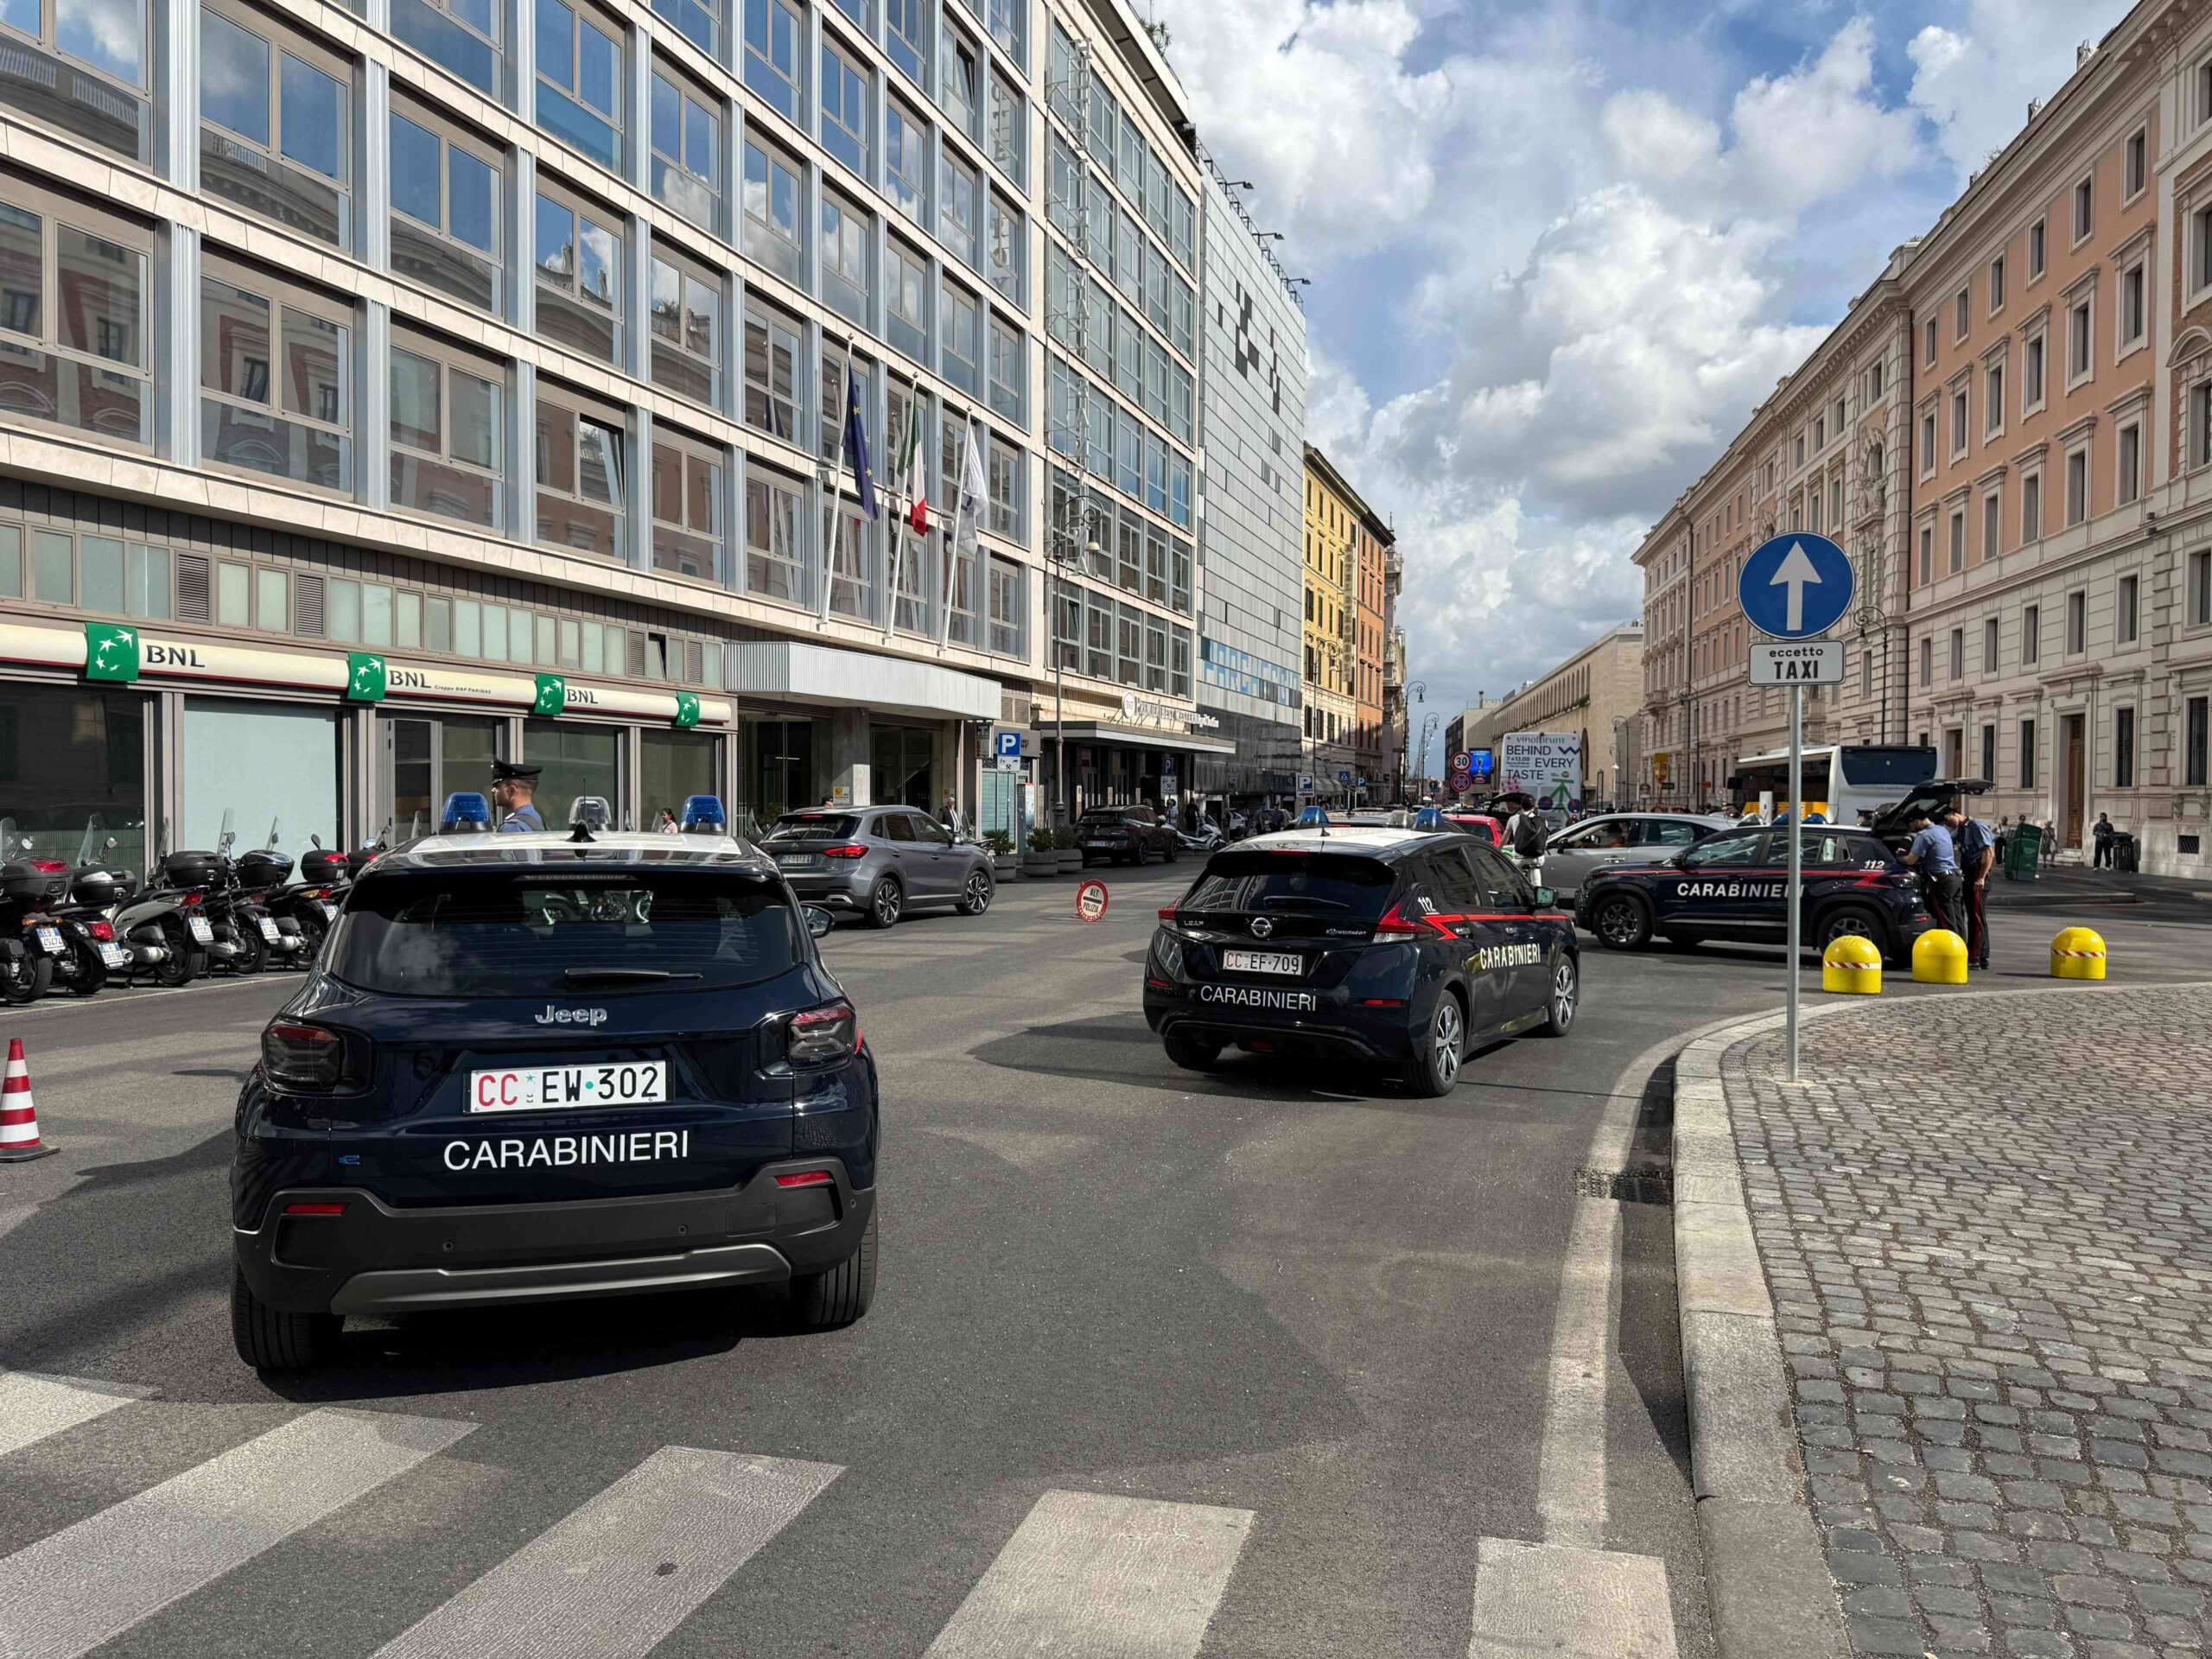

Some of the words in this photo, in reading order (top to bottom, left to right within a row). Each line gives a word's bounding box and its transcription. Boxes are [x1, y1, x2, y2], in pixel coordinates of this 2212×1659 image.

[146, 645, 206, 668] BNL
[1769, 646, 1824, 658] eccetto
[1774, 660, 1819, 679] TAXI
[390, 670, 432, 689] BNL
[567, 689, 599, 704] BNL
[1001, 734, 1017, 753] P
[1506, 746, 1552, 755] BEHIND
[1456, 757, 1467, 766] 30
[1535, 758, 1574, 768] EVERY
[1506, 769, 1544, 779] TASTE
[1865, 860, 1885, 869] 112
[1090, 888, 1099, 898] ALT
[1677, 883, 1804, 898] CARABINIEI
[1417, 896, 1436, 912] 112
[1226, 952, 1242, 969] CC
[1250, 954, 1267, 970] EF
[1273, 957, 1300, 973] 709
[1479, 944, 1541, 969] CARABINIERI
[1200, 986, 1316, 1011] CARABINIERI
[535, 1004, 607, 1027] Jeep
[478, 1074, 518, 1106] CC
[541, 1069, 583, 1103] EW
[597, 1065, 658, 1100] 302
[443, 1129, 690, 1171] CARABINIERI
